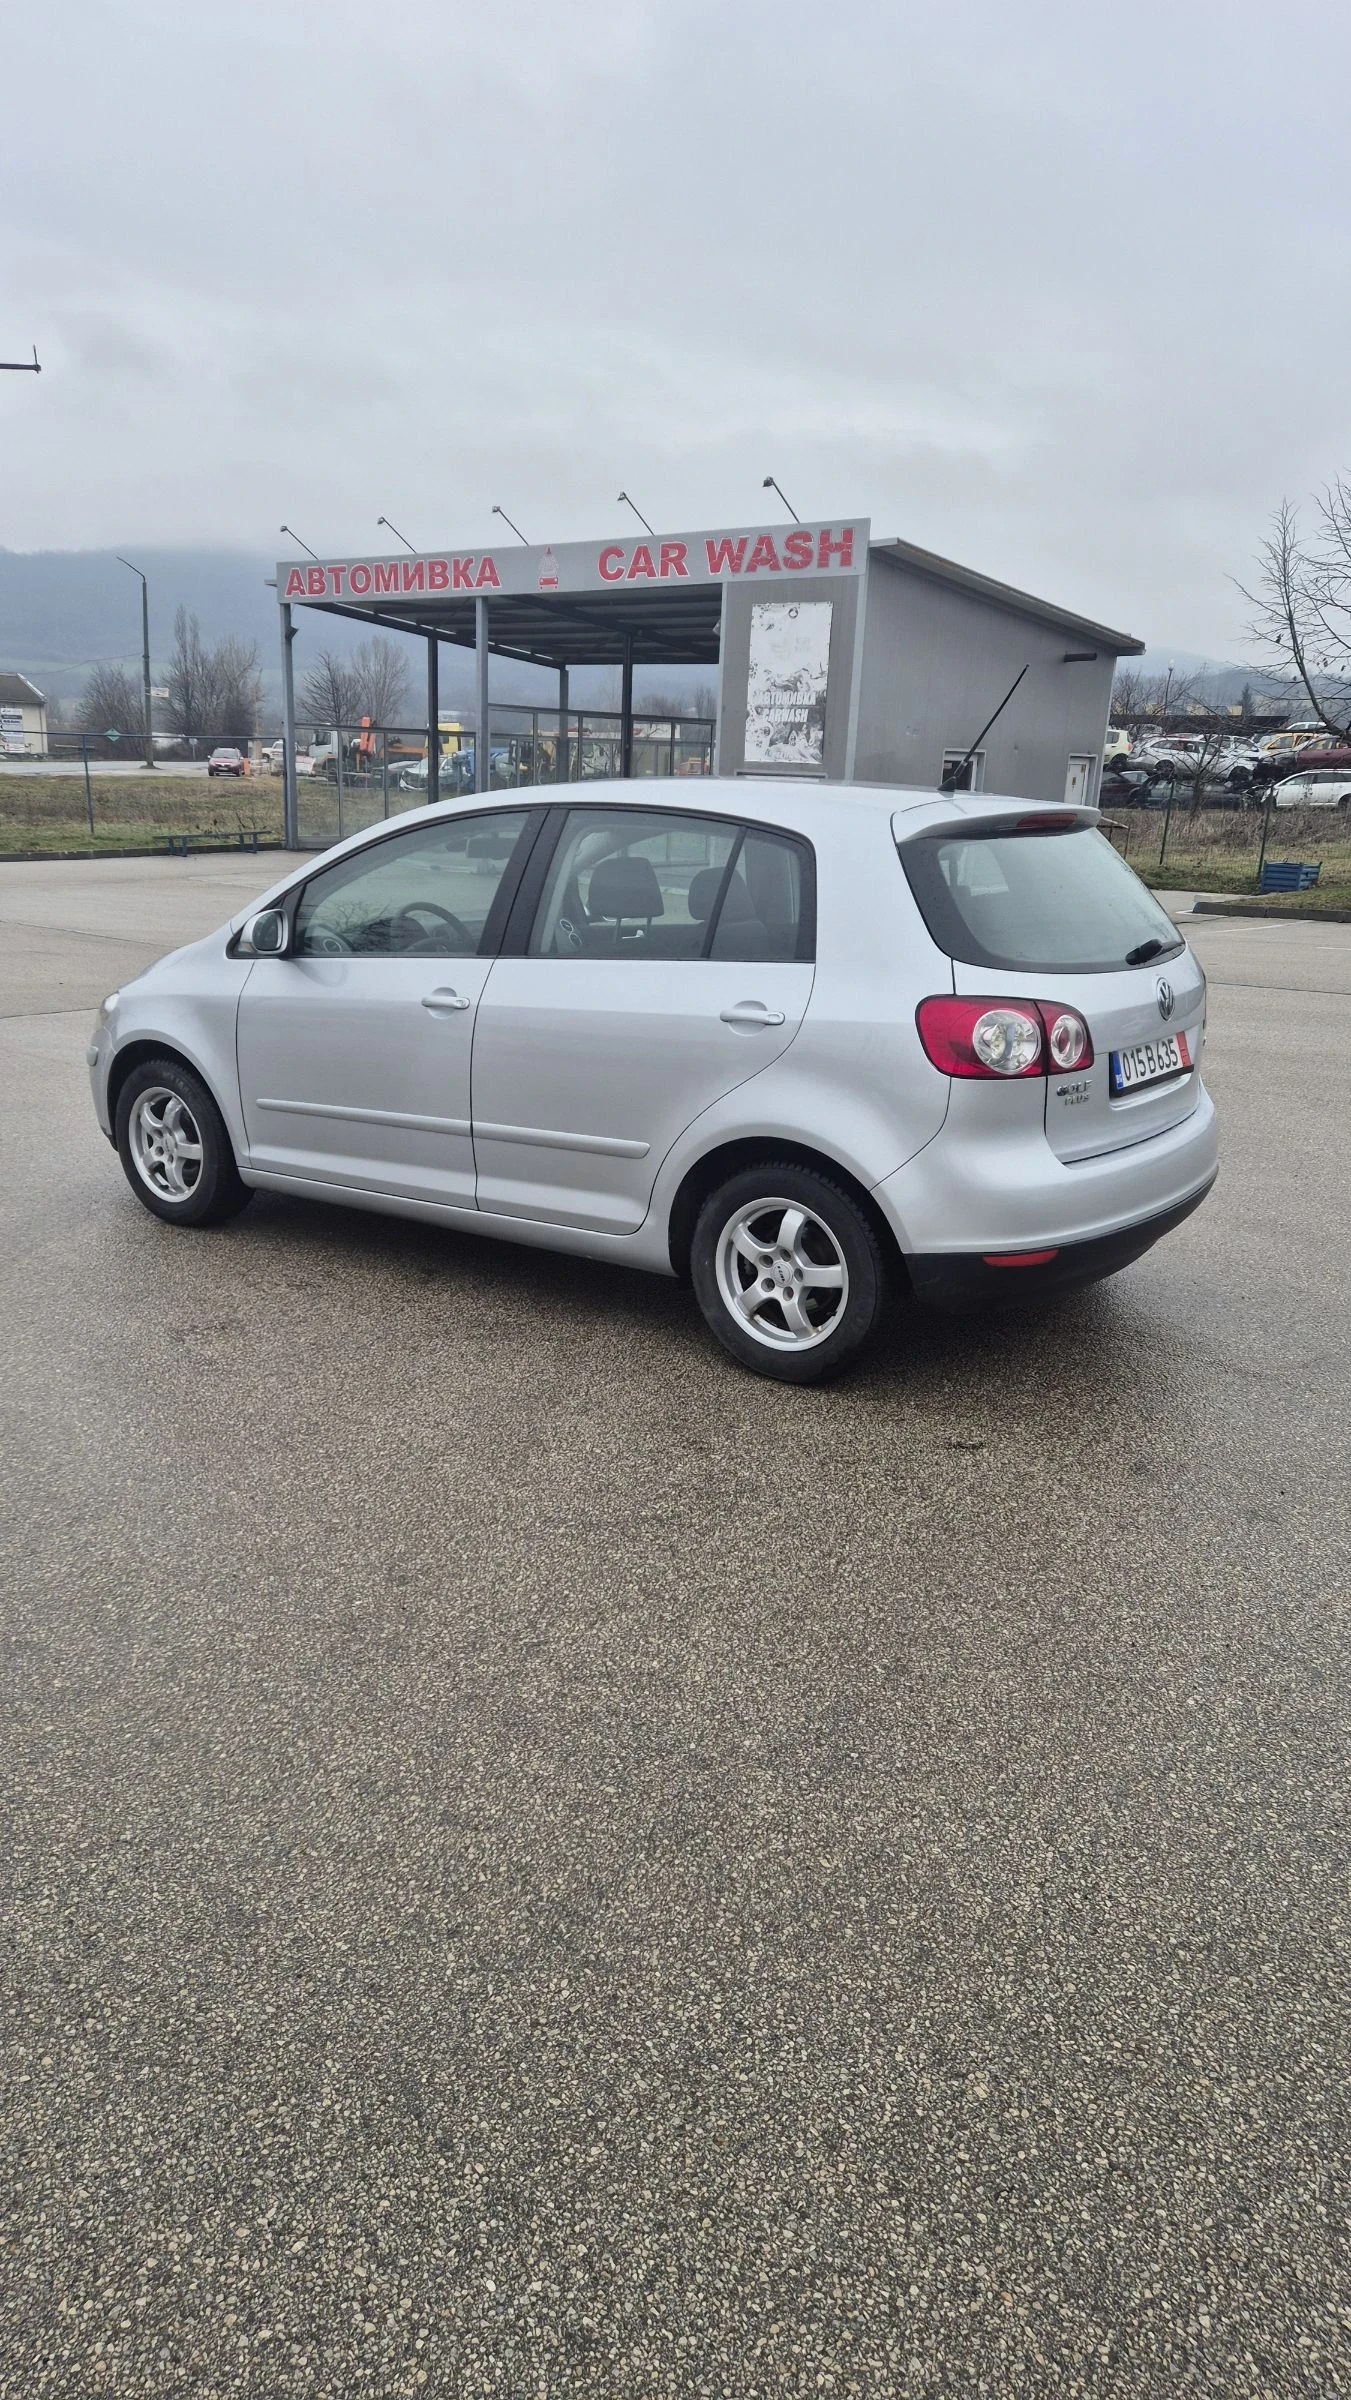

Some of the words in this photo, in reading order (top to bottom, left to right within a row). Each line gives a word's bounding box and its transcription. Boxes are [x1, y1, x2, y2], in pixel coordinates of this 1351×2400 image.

[285, 556, 501, 597] АВТОМИВКА
[597, 545, 690, 582] CAR
[704, 527, 855, 575] WASH
